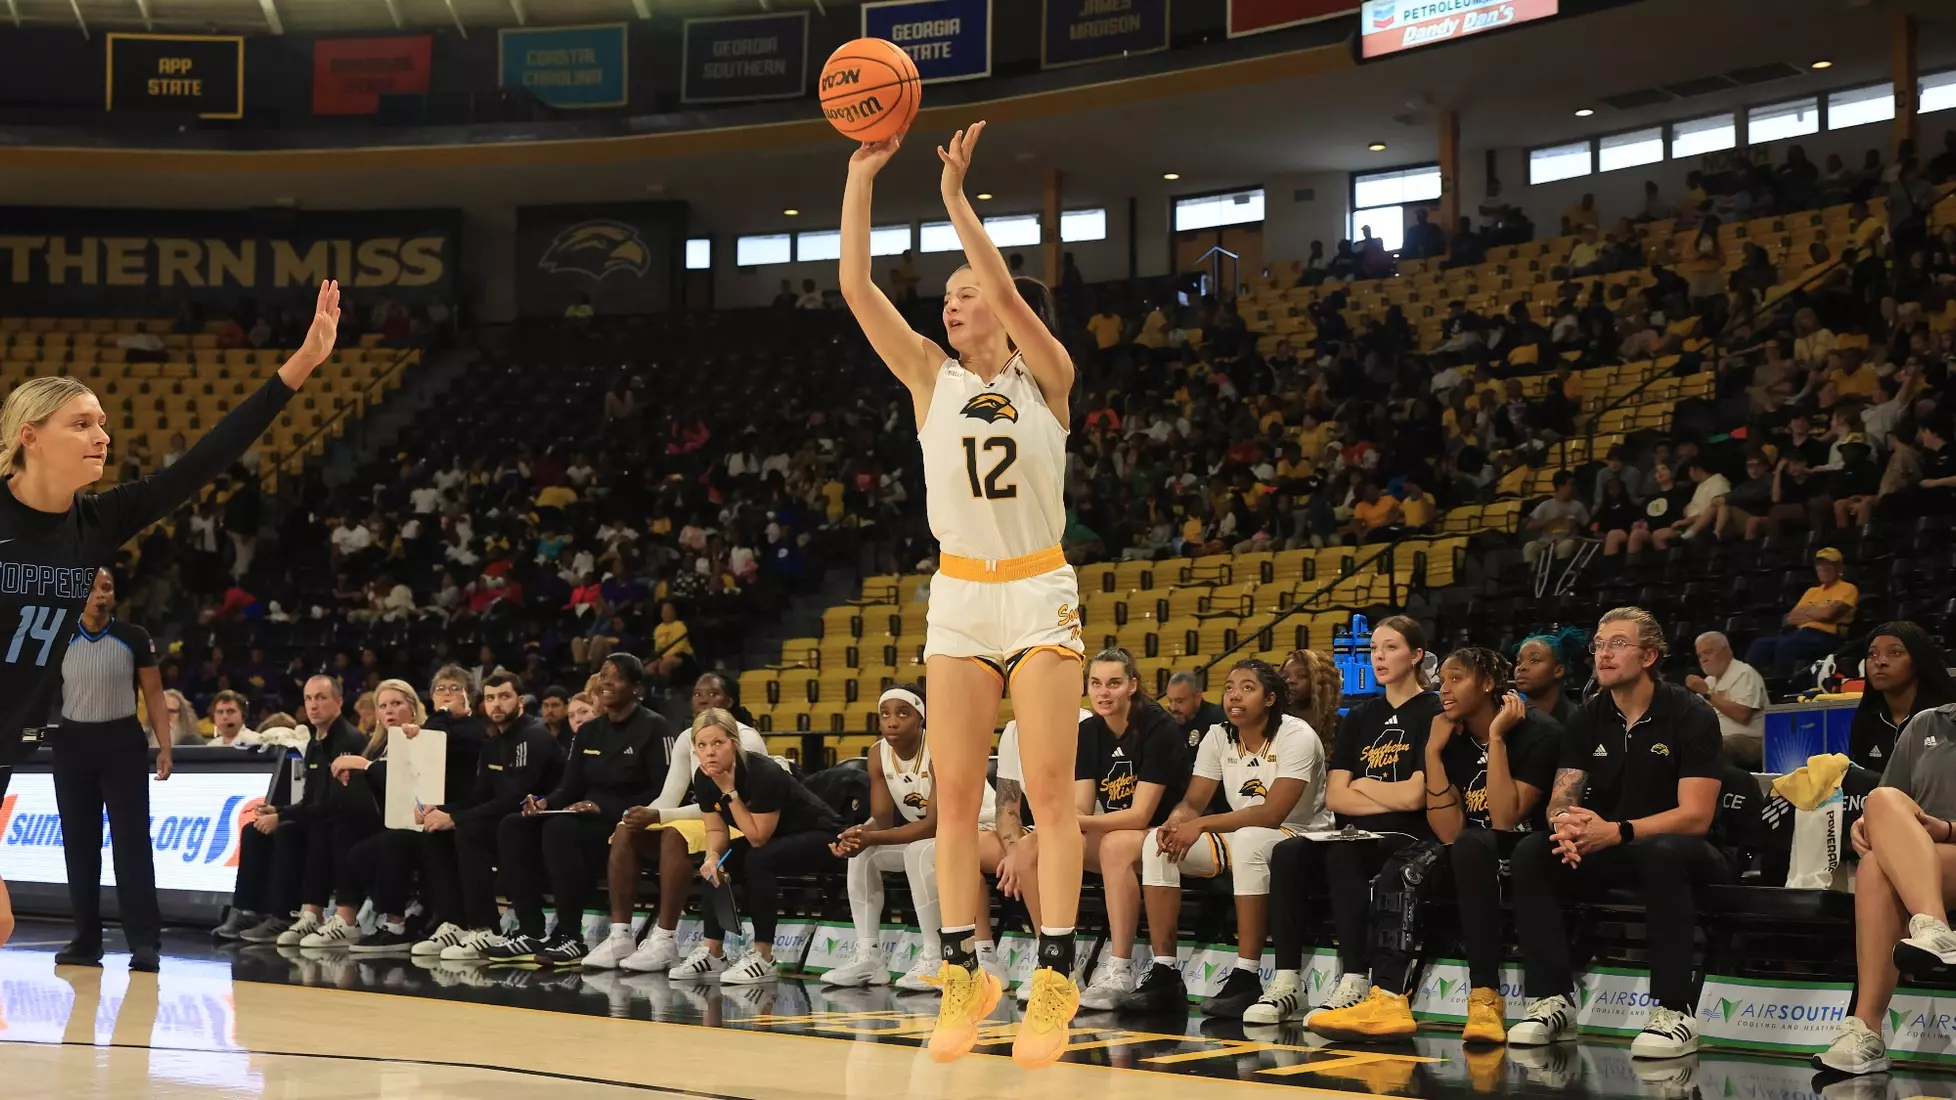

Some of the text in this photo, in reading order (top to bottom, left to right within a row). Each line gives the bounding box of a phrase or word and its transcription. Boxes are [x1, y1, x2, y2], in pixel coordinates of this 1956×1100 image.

[892, 18, 961, 41] GEORGIA
[1069, 12, 1142, 41] MADISON
[1401, 5, 1515, 46] Dandy Dan's
[158, 58, 193, 75] APP
[702, 59, 786, 79] SOUTHERN
[147, 77, 202, 97] STATE
[822, 68, 861, 92] NCAA
[824, 96, 884, 123] Wilson
[269, 236, 446, 288] MISS
[961, 435, 1018, 501] 12
[0, 561, 95, 599] OPPERS
[5, 605, 68, 667] 14
[1360, 740, 1410, 761] Southern
[1368, 754, 1400, 769] Miss
[1629, 1008, 1645, 1016] AND
[1741, 1003, 1844, 1021] AIRSOUTH
[1737, 1020, 1777, 1029] COOLING
[1781, 1023, 1799, 1031] AND
